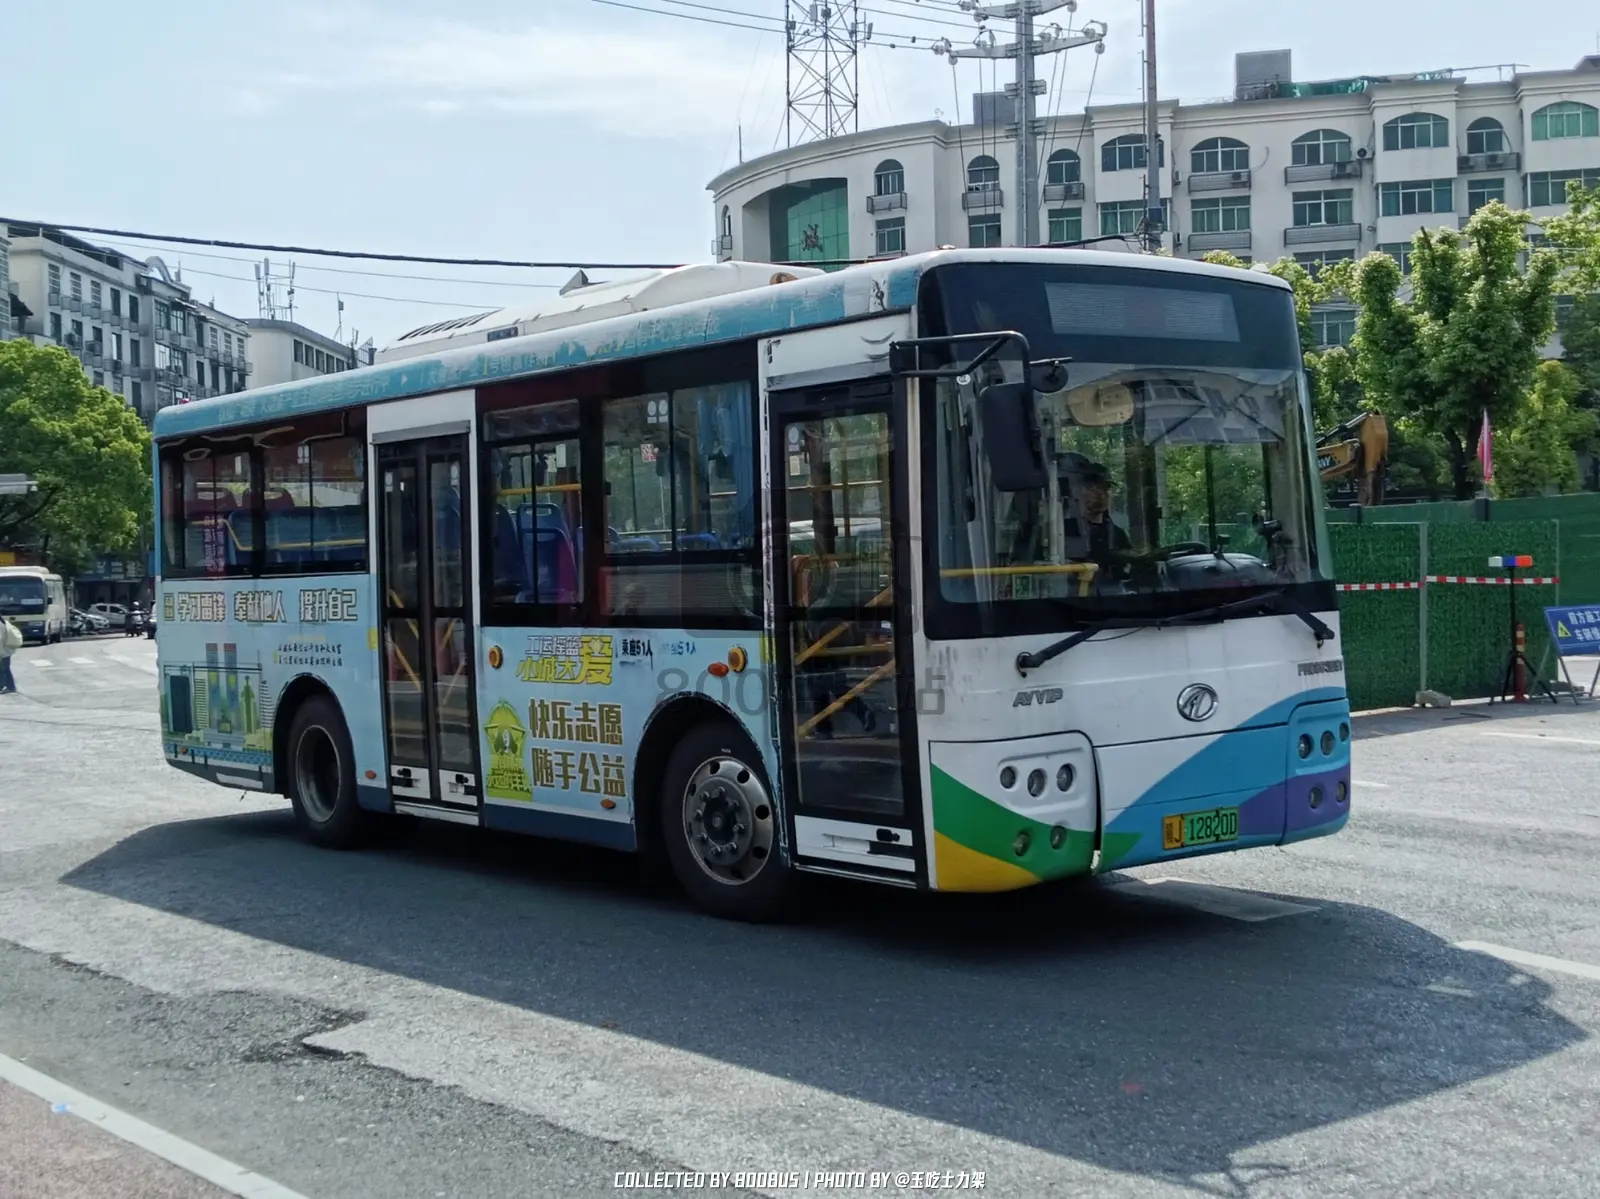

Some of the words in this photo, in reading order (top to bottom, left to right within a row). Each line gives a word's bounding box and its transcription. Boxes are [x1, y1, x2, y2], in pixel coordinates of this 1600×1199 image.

[177, 591, 226, 622] 学习雷锋
[234, 590, 287, 622] 奉献他人
[299, 588, 358, 622] 提升自己
[528, 699, 623, 746] 快乐志愿
[531, 748, 627, 797] 随手公益
